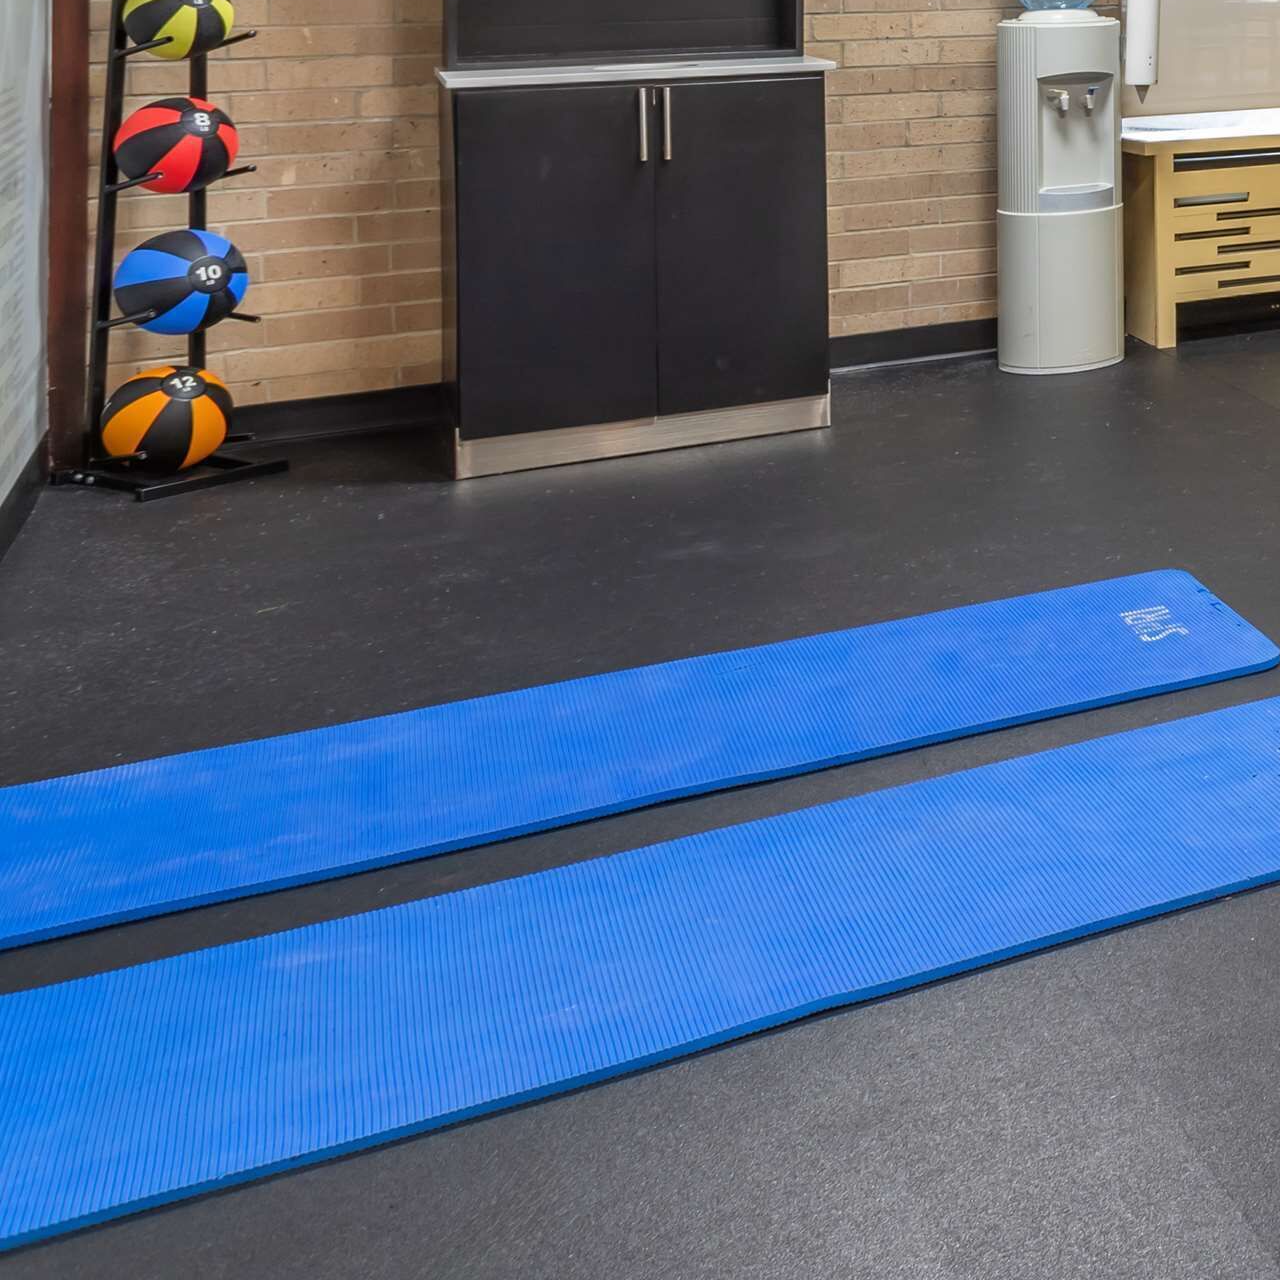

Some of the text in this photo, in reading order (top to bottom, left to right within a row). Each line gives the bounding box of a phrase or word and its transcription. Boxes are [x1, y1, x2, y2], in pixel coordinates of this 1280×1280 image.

[194, 112, 210, 126] 8
[195, 264, 222, 281] 10
[170, 376, 197, 388] 12
